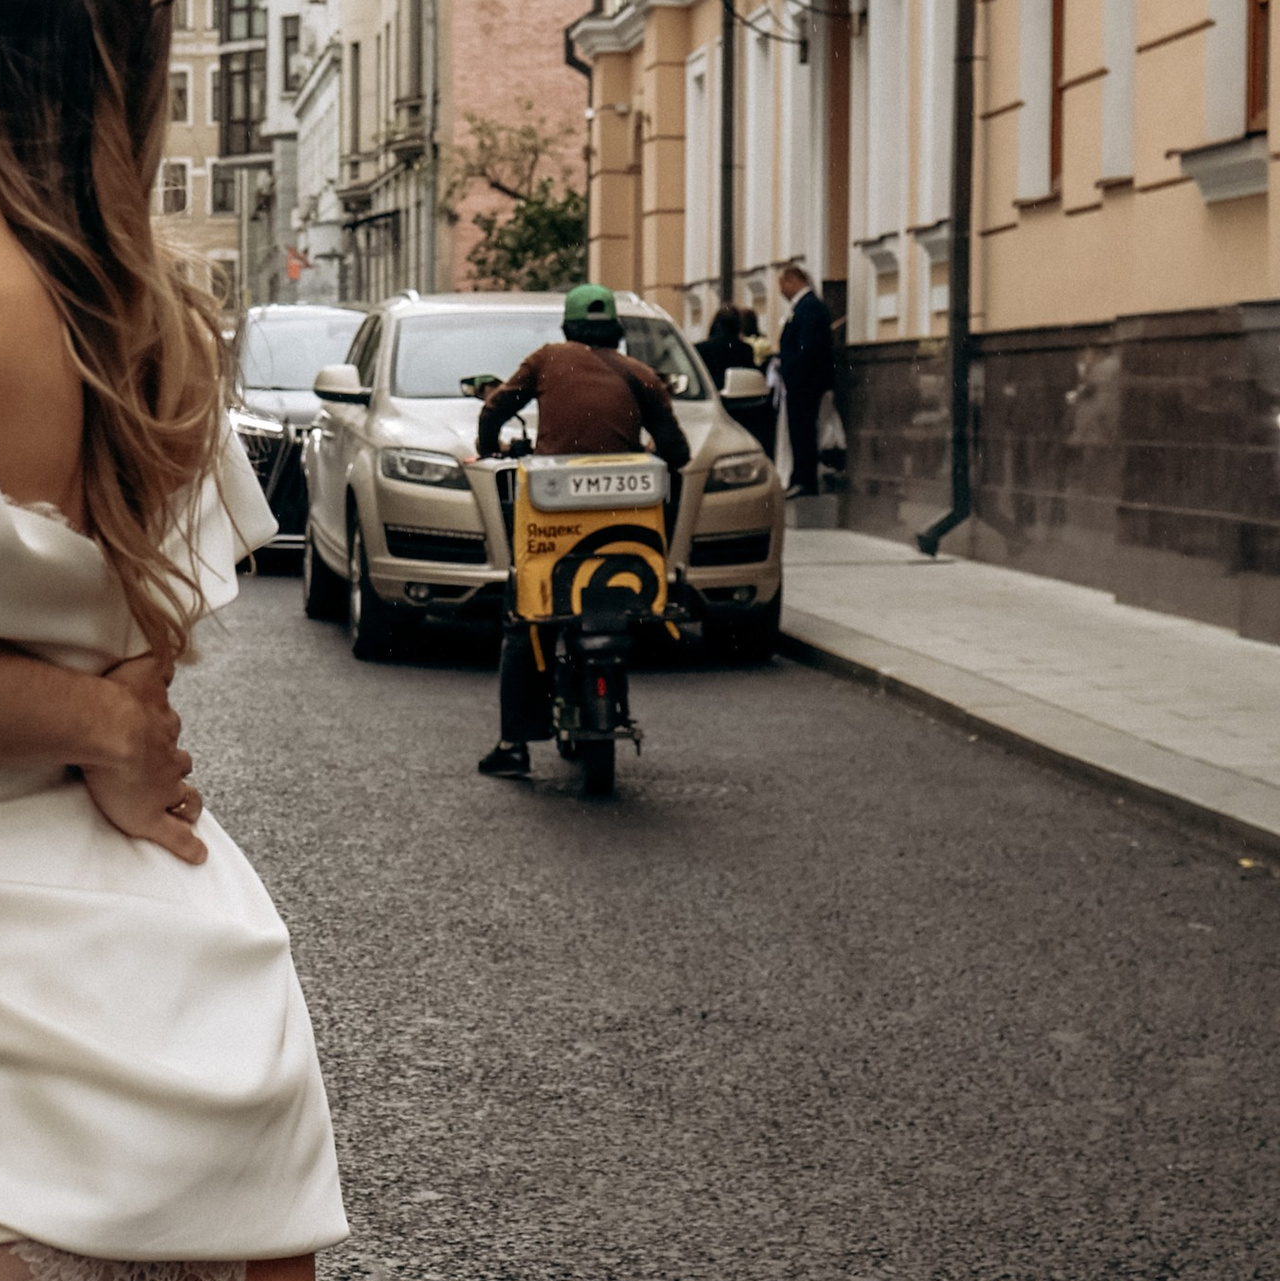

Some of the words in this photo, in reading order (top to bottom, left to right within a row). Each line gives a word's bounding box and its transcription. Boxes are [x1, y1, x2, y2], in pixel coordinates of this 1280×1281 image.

[573, 475, 651, 492] УМ7305
[528, 524, 581, 538] Яндекс
[528, 540, 556, 554] Еда
